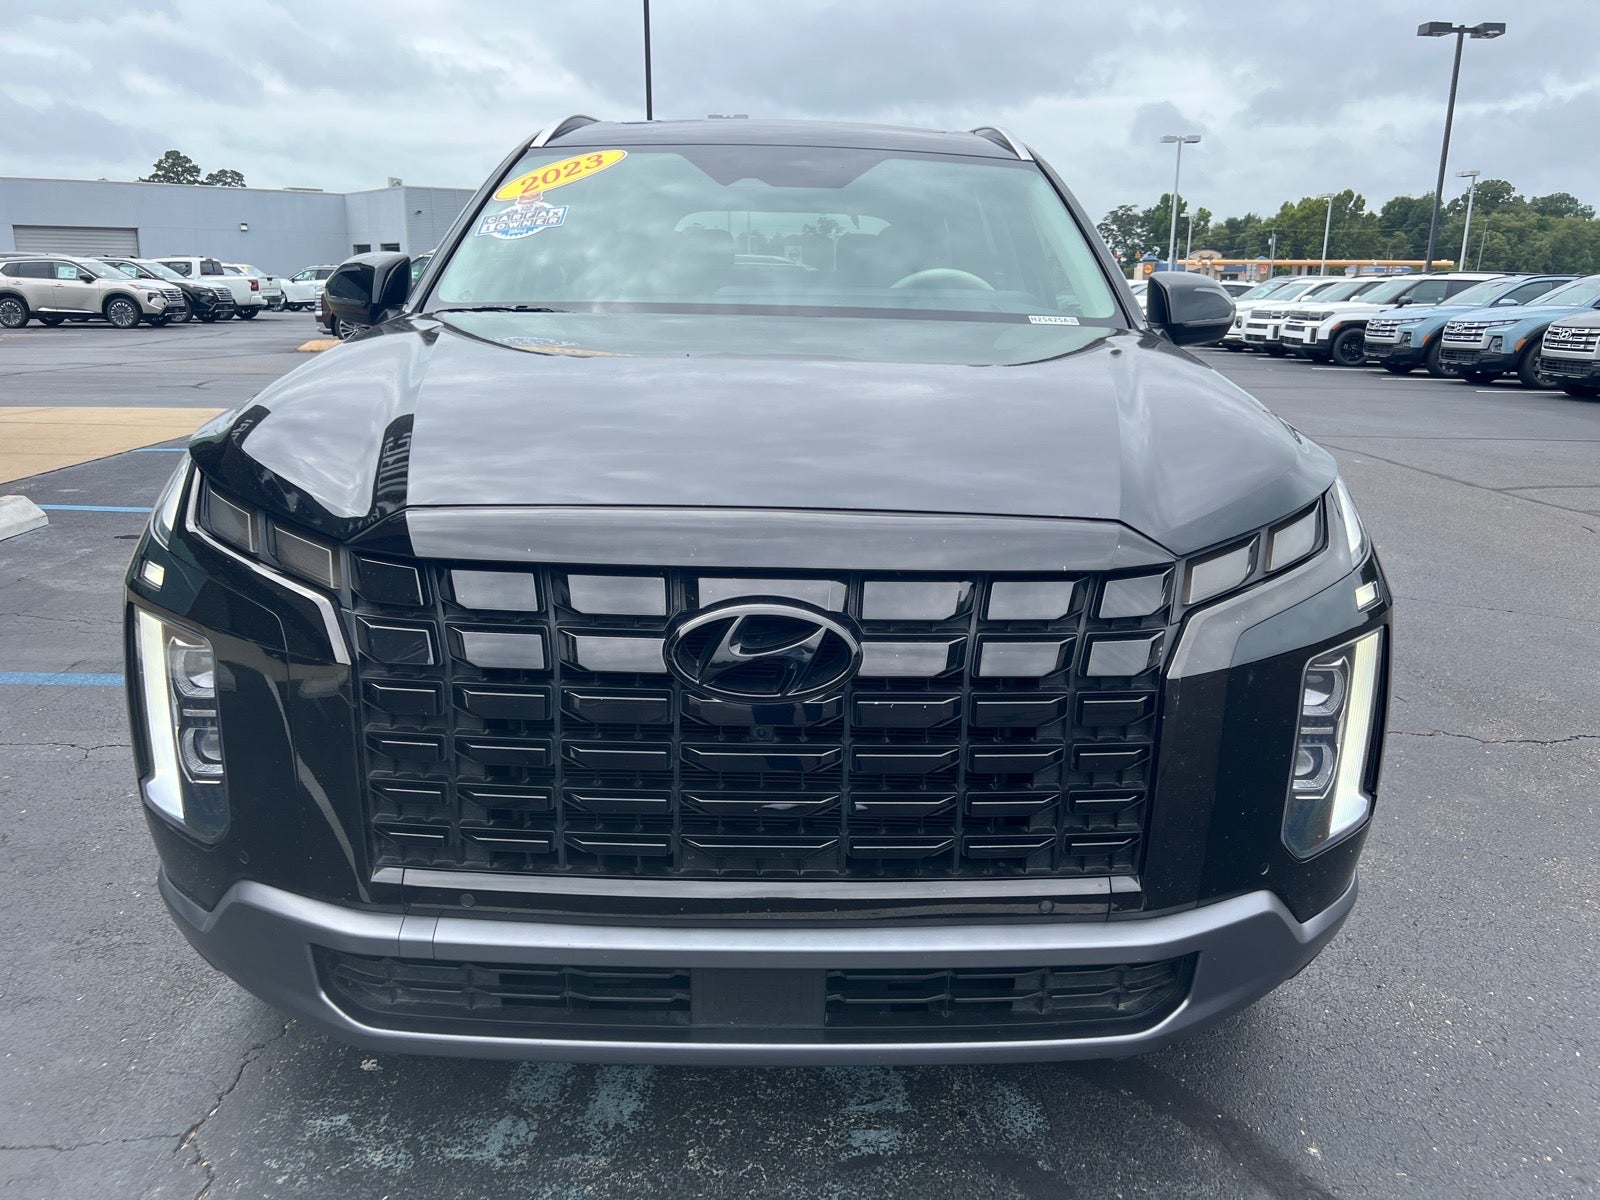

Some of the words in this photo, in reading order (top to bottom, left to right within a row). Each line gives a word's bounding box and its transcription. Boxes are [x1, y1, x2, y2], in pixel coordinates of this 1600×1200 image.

[520, 153, 604, 194] 2023
[487, 209, 561, 223] CARFAX
[496, 217, 558, 230] OWNER
